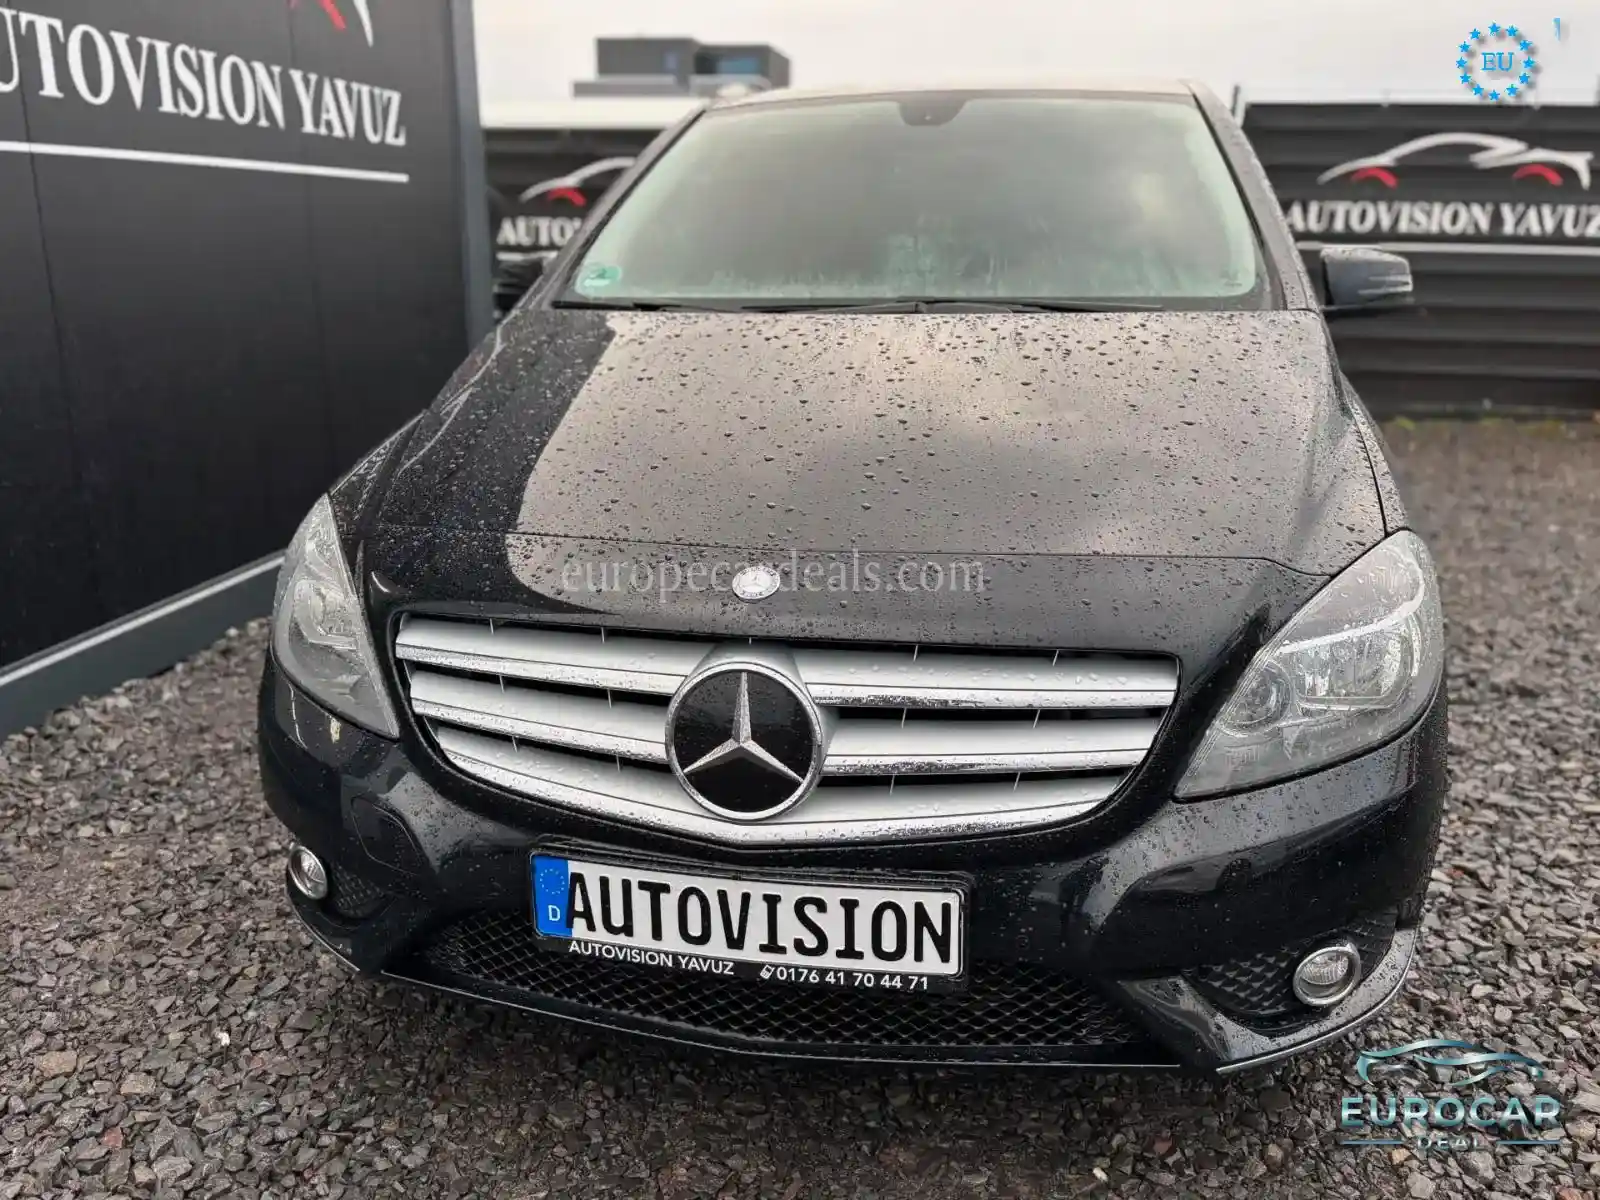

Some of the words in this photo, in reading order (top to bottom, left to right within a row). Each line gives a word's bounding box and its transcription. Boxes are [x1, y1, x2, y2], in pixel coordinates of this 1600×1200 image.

[288, 68, 406, 146] YAVUZ
[496, 216, 582, 247] AUTO
[1285, 199, 1494, 235] AUTOVISION
[548, 905, 561, 922] D
[566, 872, 951, 964] AUTOVISION
[568, 940, 674, 968] AUTOVISION
[677, 955, 735, 976] YAVUZ
[776, 967, 820, 984] 0176
[825, 972, 845, 987] 41
[854, 974, 875, 988] 70
[880, 975, 902, 989] 44
[908, 976, 929, 990] 71
